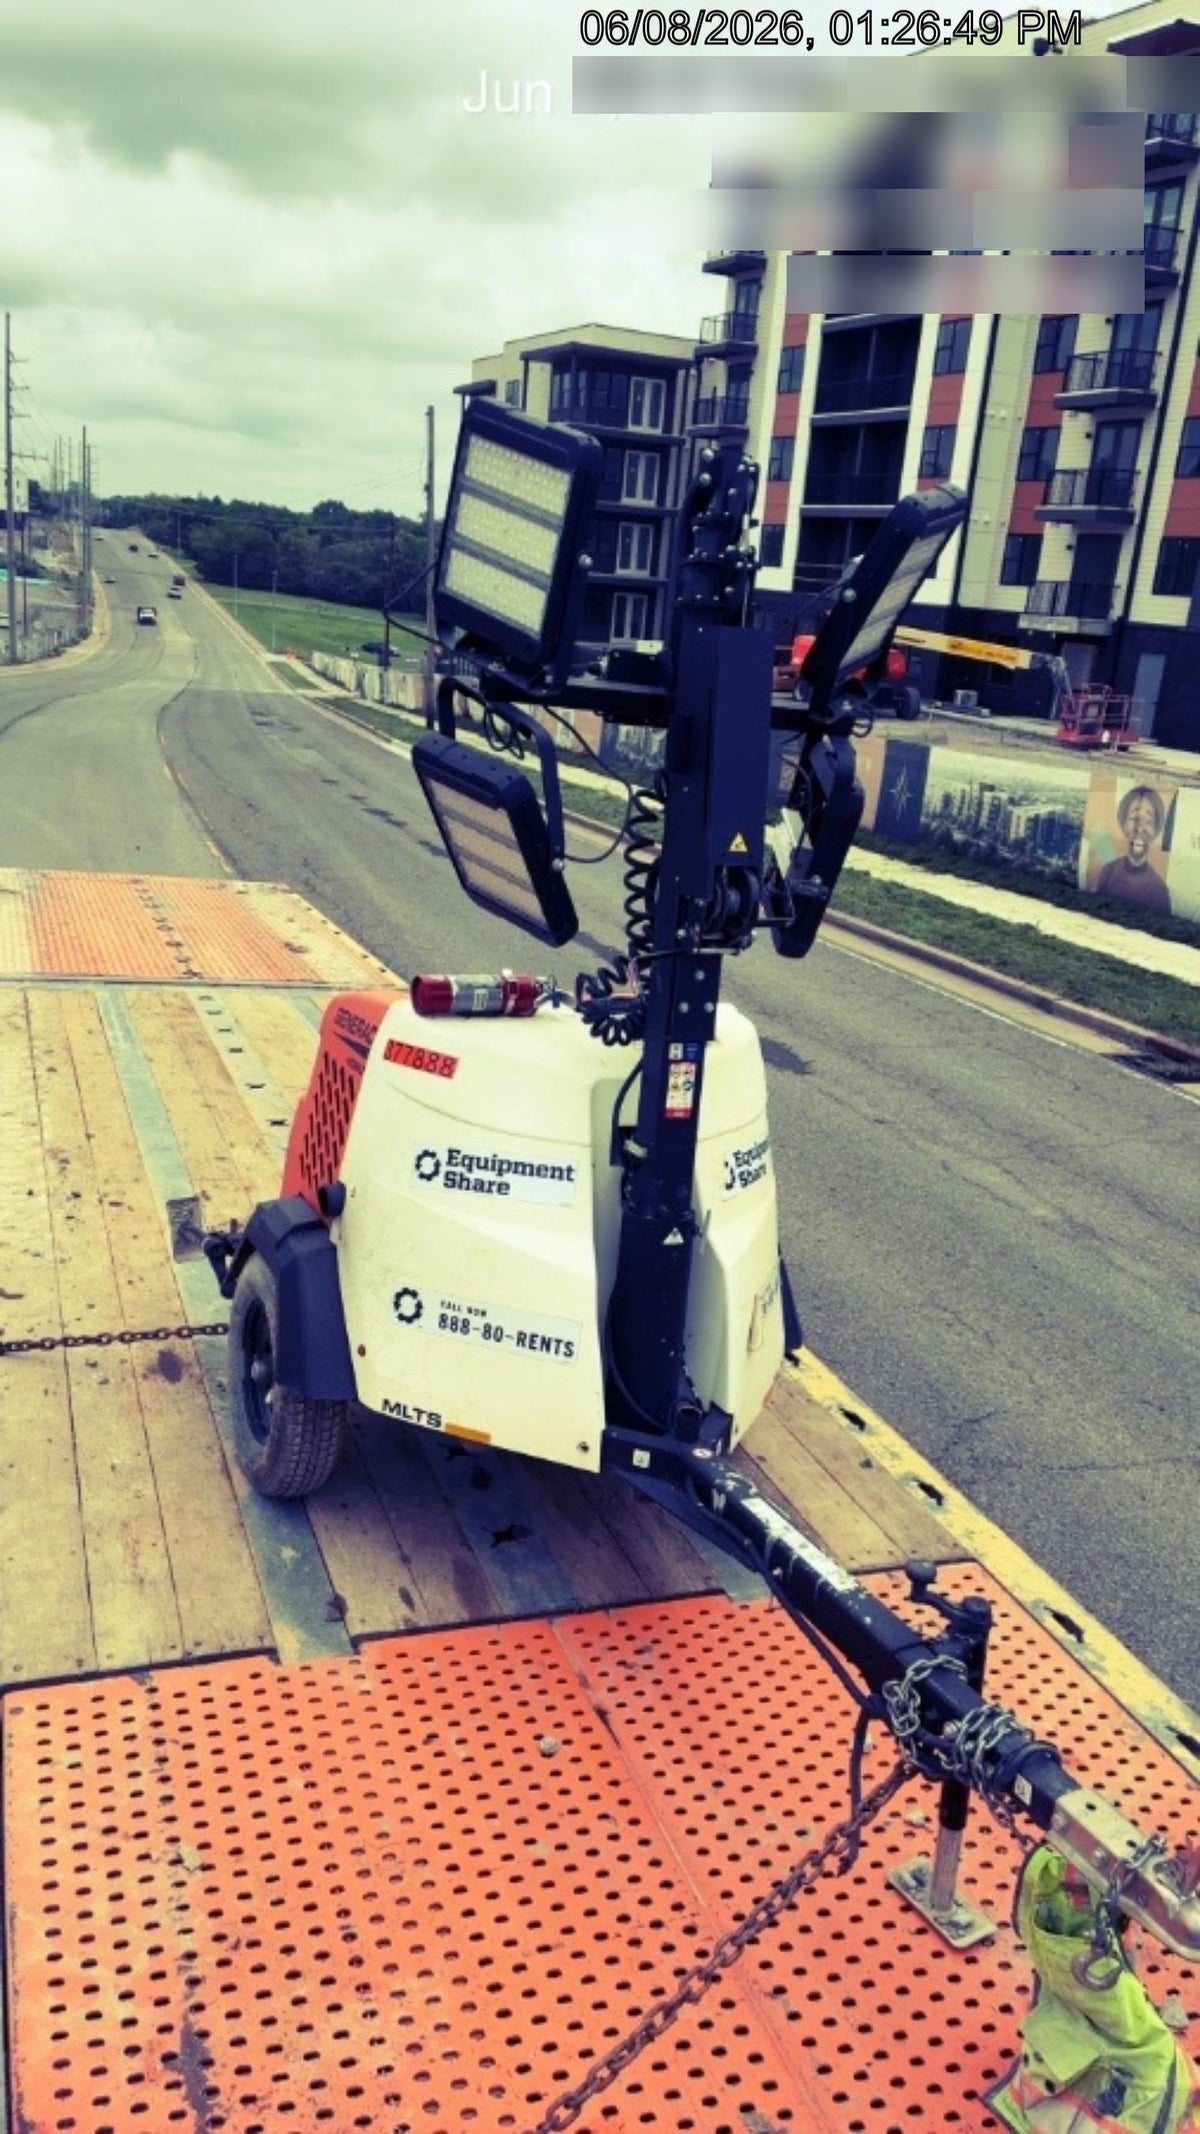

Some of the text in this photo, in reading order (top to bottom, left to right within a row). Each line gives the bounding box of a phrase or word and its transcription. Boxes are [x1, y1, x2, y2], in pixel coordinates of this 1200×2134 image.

[445, 1147, 575, 1182] Equipment
[443, 1170, 511, 1196] Share
[438, 1313, 575, 1358] 888-80-RENTS
[381, 1398, 442, 1428] MLTS
